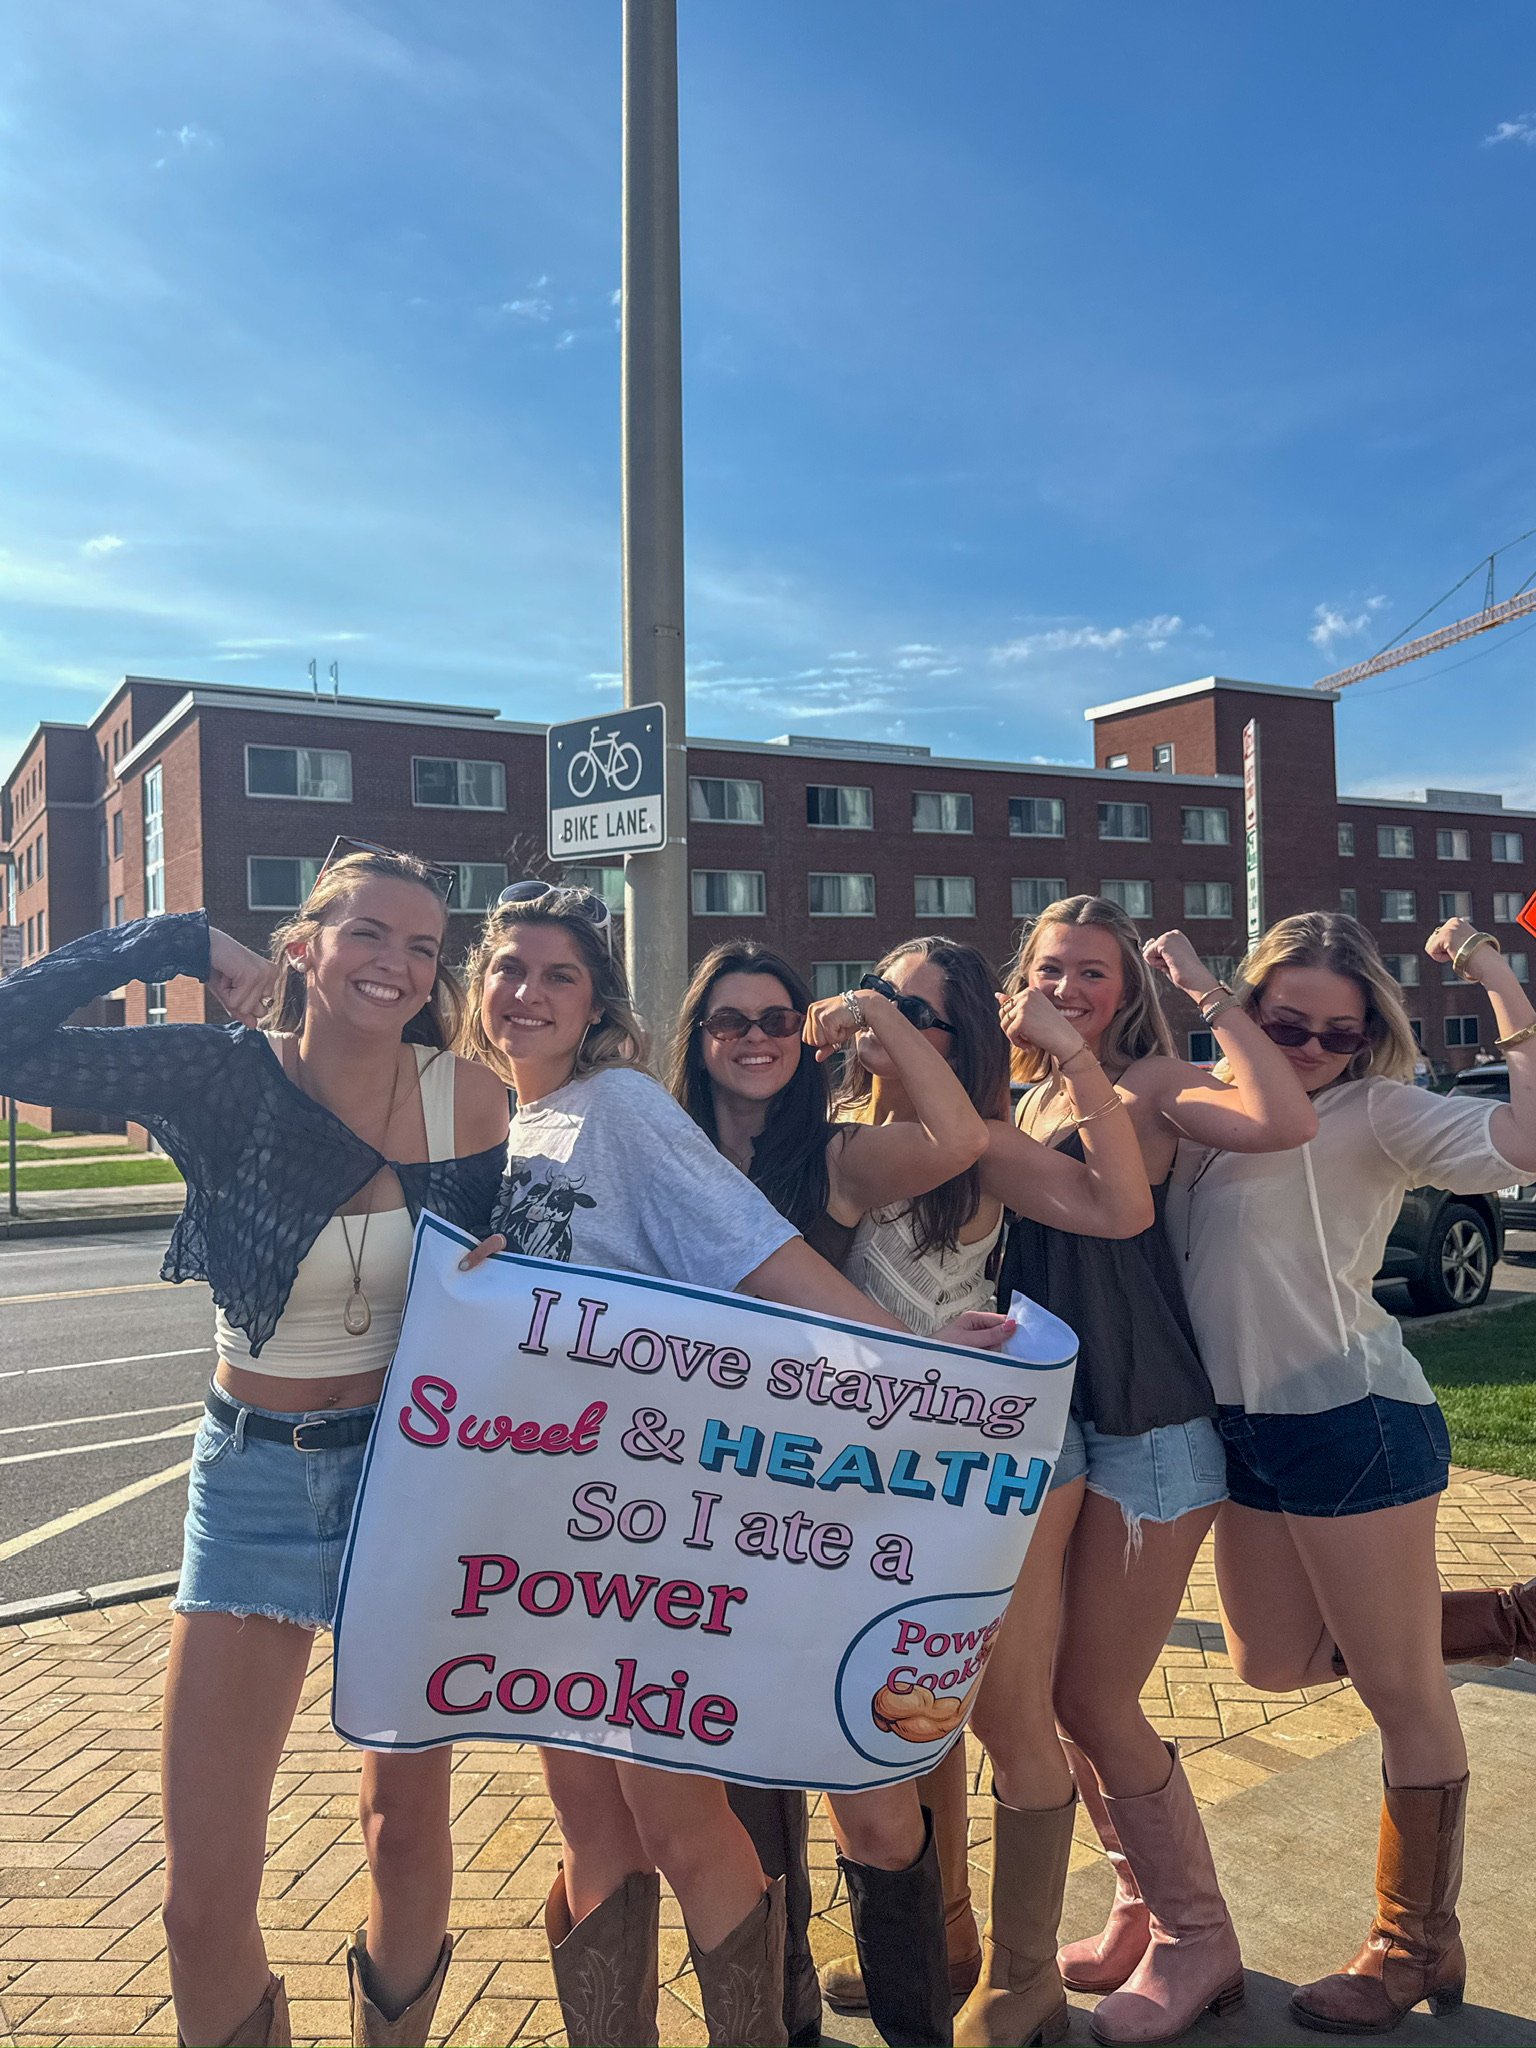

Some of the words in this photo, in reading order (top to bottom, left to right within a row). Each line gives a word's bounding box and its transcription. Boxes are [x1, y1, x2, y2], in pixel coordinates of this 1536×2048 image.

[564, 815, 599, 843] BIKE
[606, 808, 648, 838] LANE
[518, 1287, 562, 1356] I
[566, 1297, 751, 1389] Love
[767, 1356, 1037, 1439] staying
[398, 1374, 609, 1456] Sweet
[620, 1407, 685, 1464] &
[699, 1418, 1052, 1516] HEALTH
[567, 1481, 666, 1542] So
[683, 1490, 723, 1550] I
[734, 1510, 854, 1568] ate
[870, 1533, 914, 1584] a
[451, 1554, 748, 1635] Power
[891, 1612, 1004, 1657] Powe
[426, 1653, 739, 1744] Cookie
